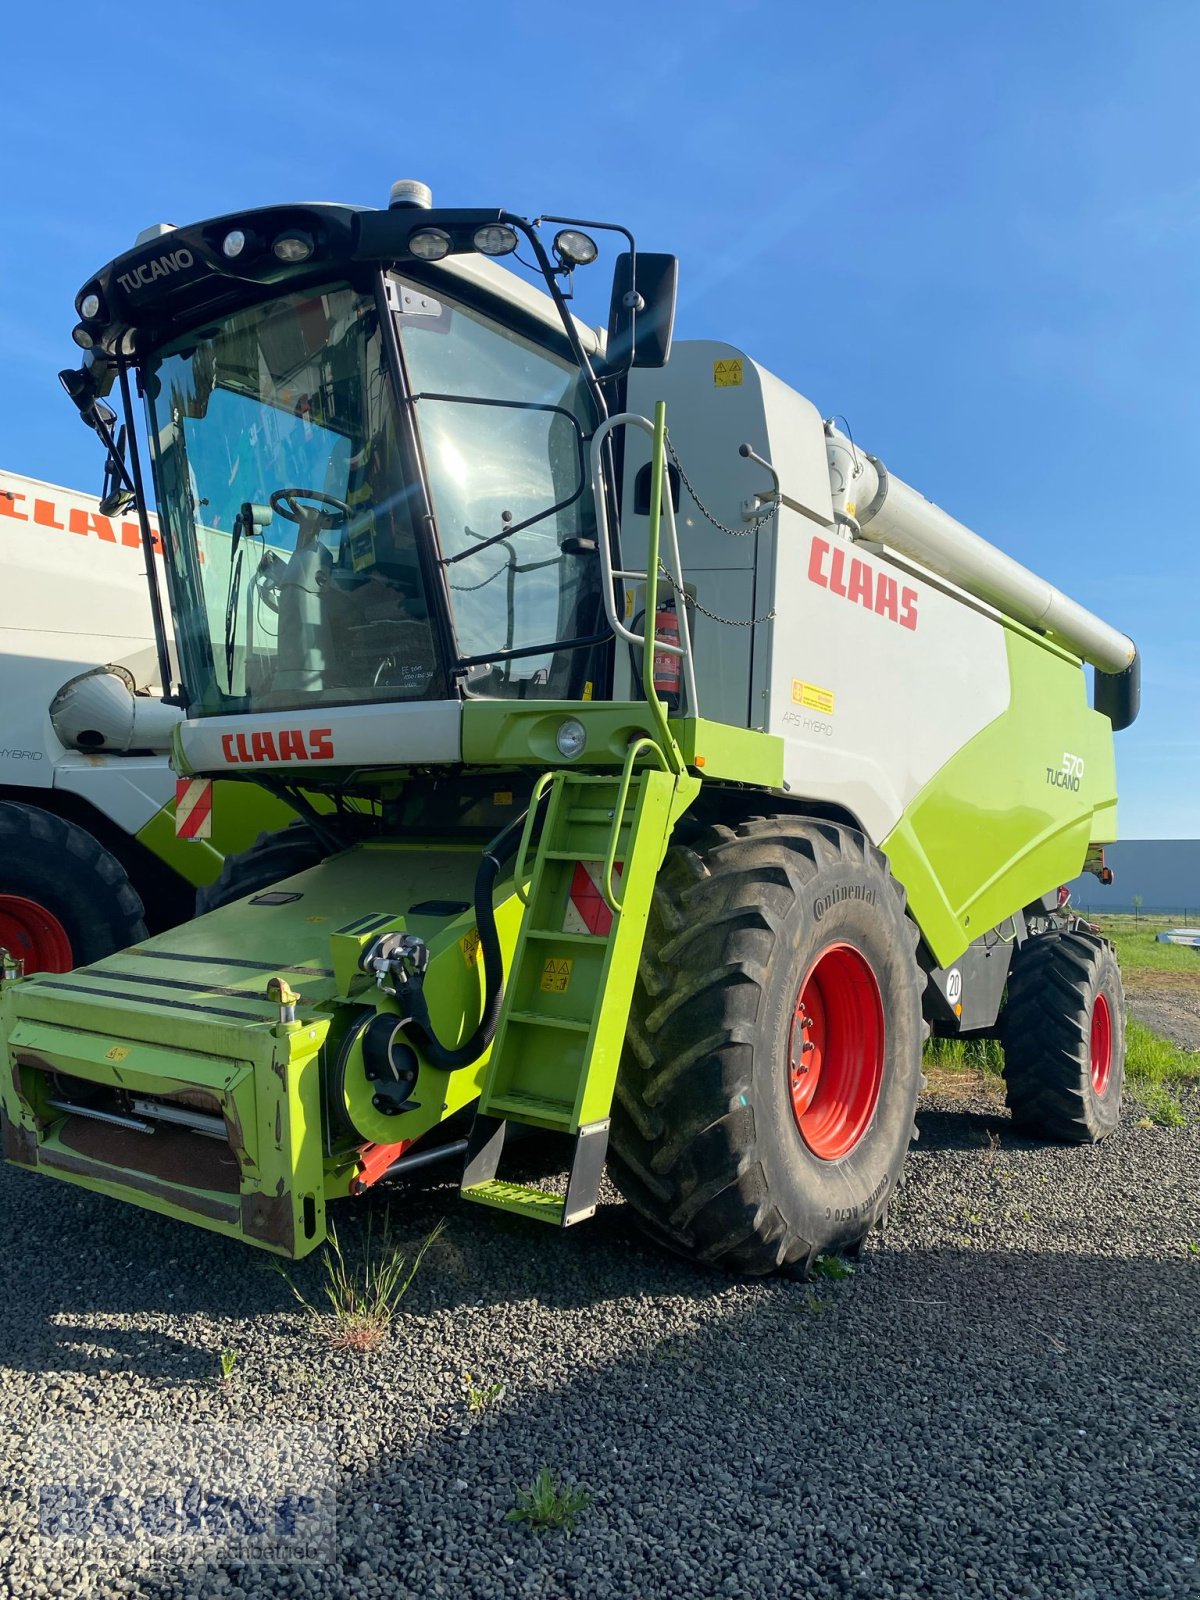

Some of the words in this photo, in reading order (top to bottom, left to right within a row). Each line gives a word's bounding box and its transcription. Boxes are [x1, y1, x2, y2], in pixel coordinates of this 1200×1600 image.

[116, 248, 194, 294] TUCANO
[0, 489, 205, 564] CLAA
[807, 535, 919, 632] CLAAS
[782, 711, 801, 727] APS
[803, 718, 833, 737] HYBRID
[221, 728, 334, 763] CLAAS
[1046, 767, 1080, 793] TUCANO
[1061, 752, 1085, 779] 570
[813, 884, 877, 923] Continental
[948, 974, 960, 997] 20
[834, 1205, 858, 1222] AC70
